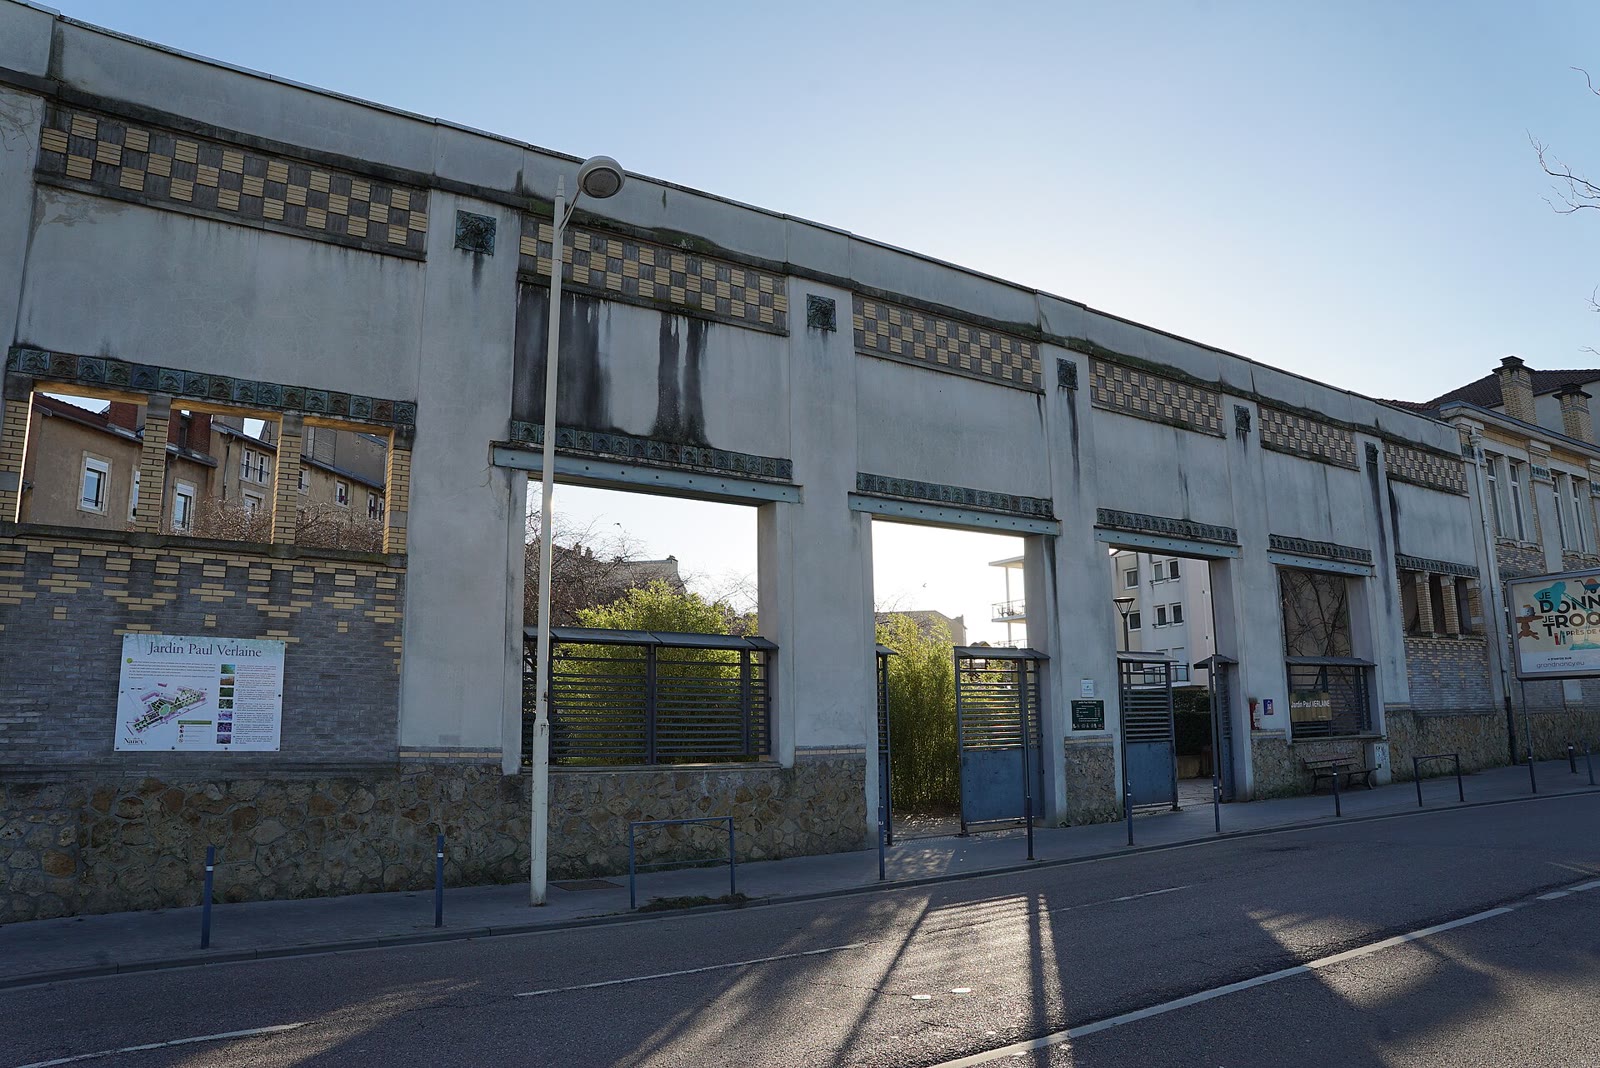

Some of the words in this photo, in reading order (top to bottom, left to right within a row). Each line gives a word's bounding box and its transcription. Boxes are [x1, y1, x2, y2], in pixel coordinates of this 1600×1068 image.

[1542, 615, 1555, 623] JE
[148, 642, 184, 656] Jardin
[188, 643, 212, 654] Paul
[217, 645, 262, 657] Verlaine
